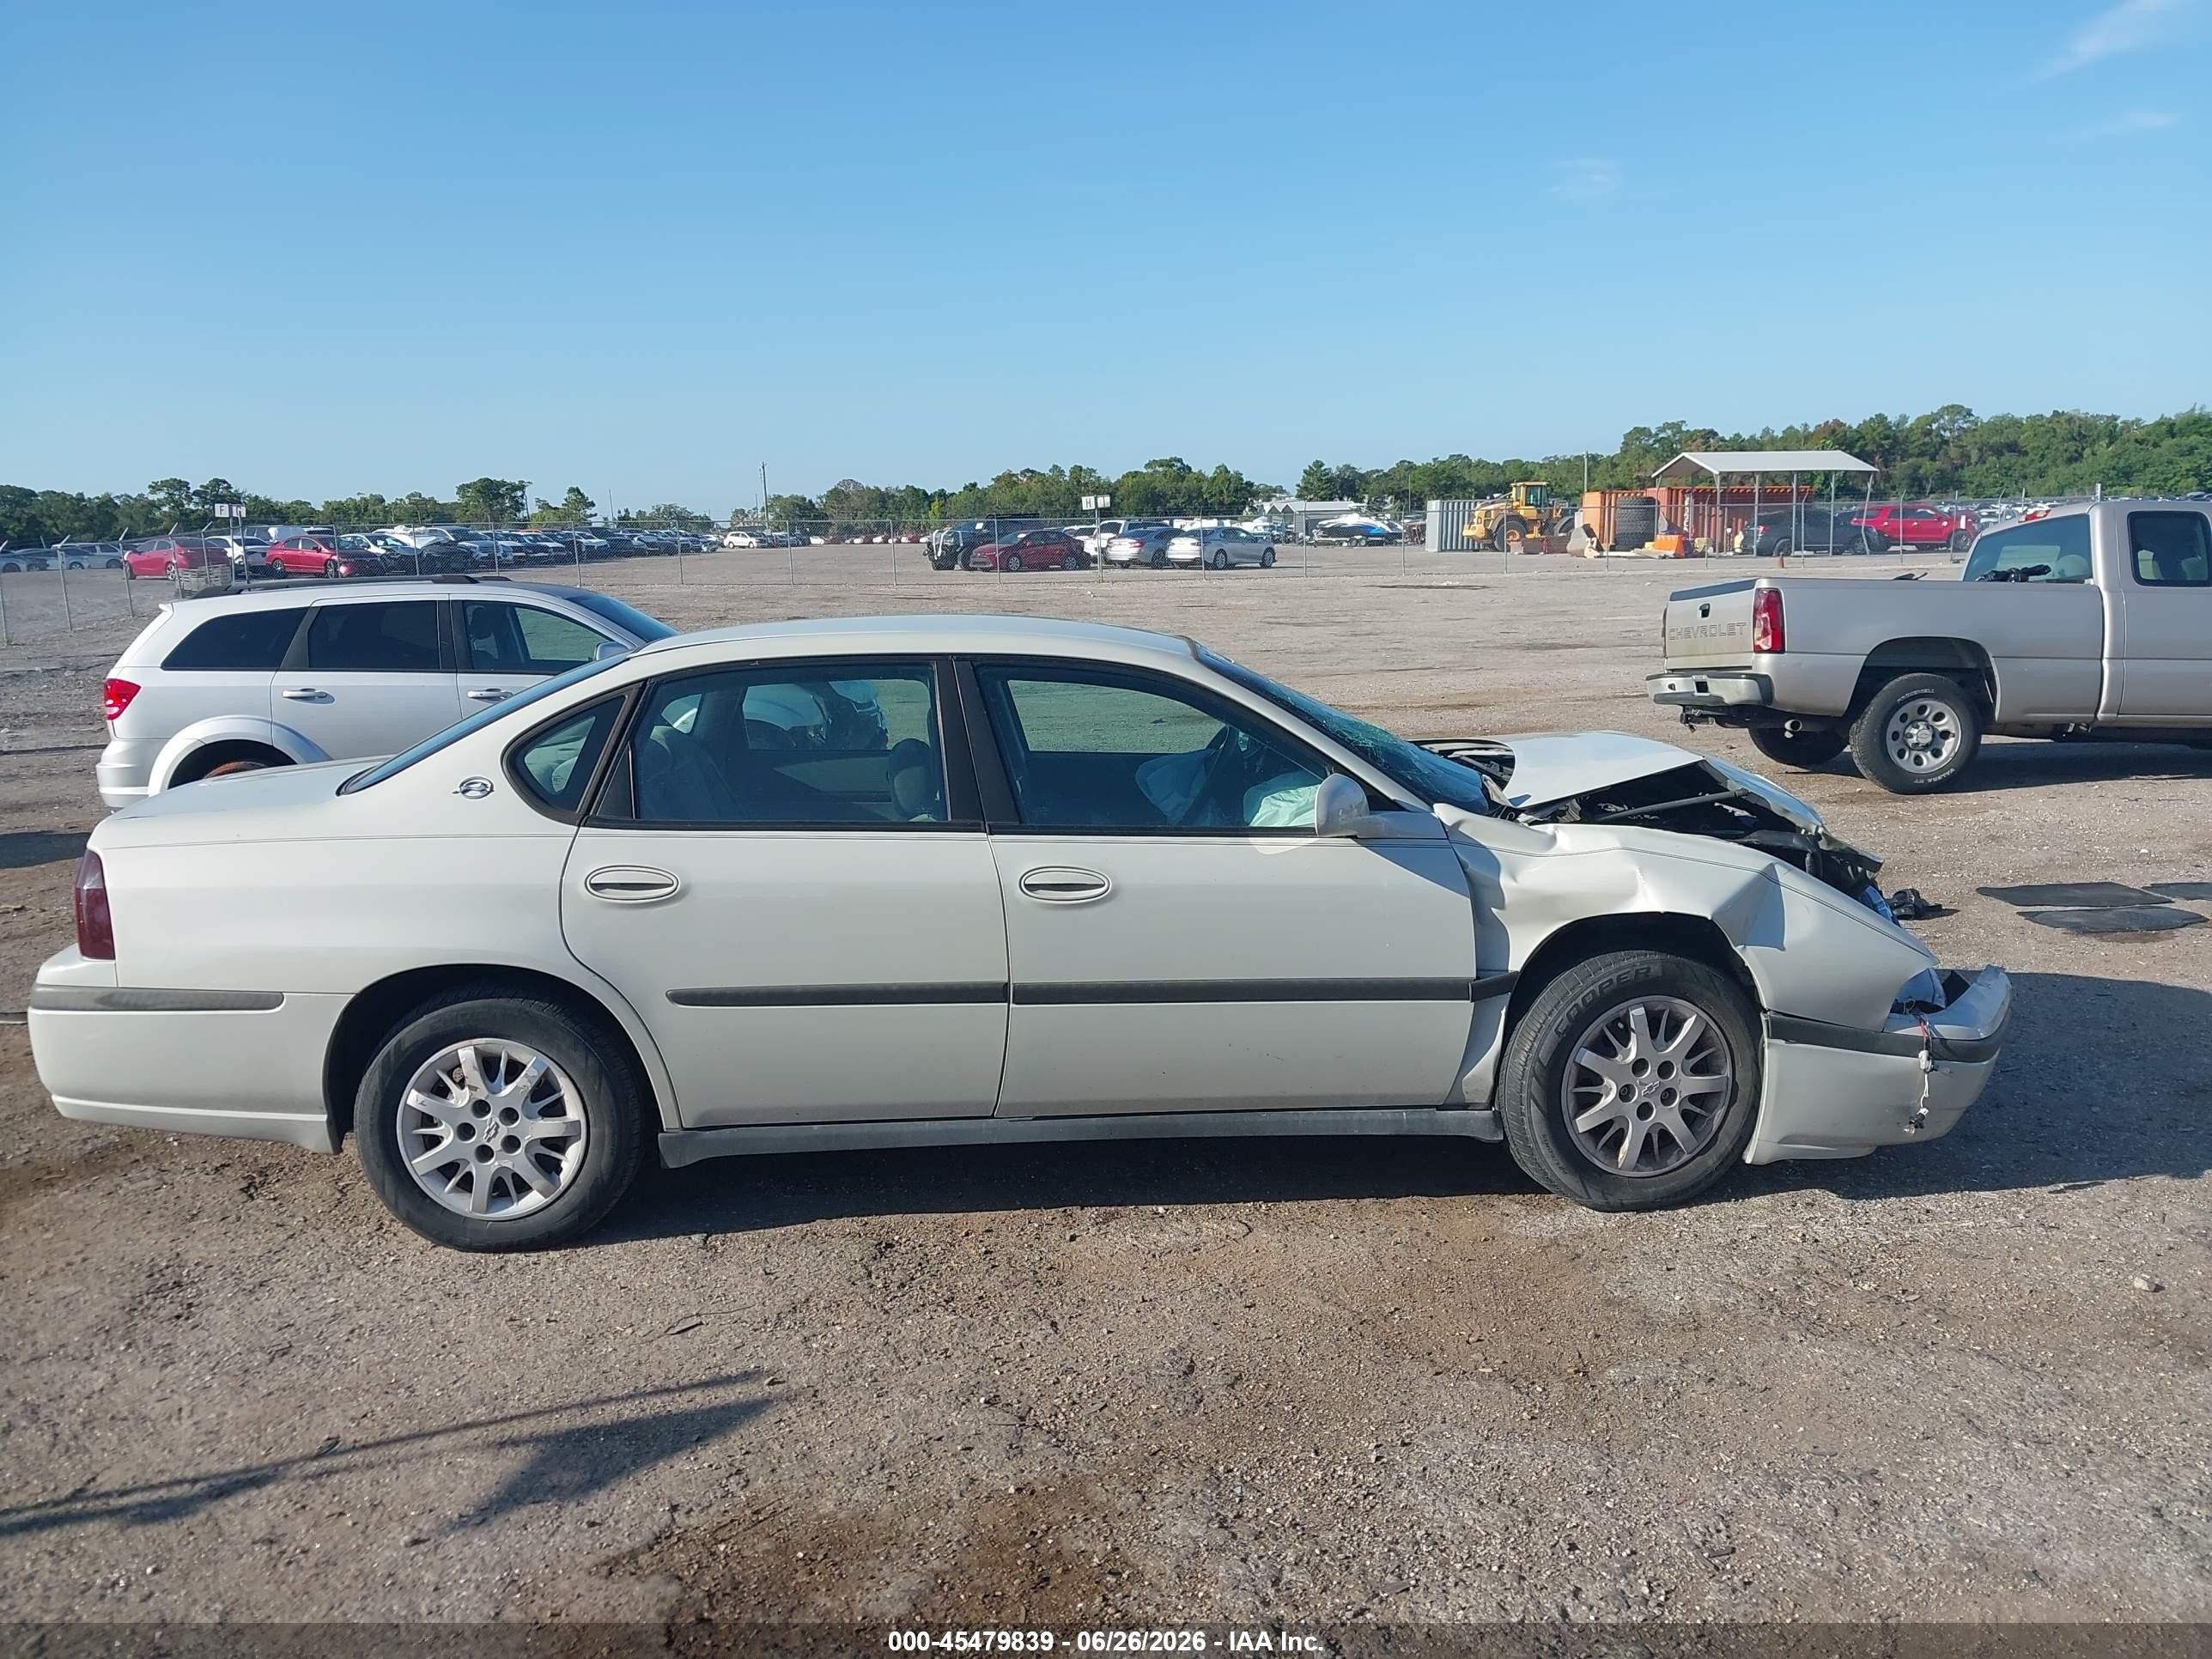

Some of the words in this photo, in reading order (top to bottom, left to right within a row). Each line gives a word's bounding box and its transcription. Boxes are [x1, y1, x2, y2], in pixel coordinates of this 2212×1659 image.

[220, 505, 224, 516] F
[1668, 621, 1747, 641] CHEVROLET
[1553, 966, 1652, 1038] COOPER
